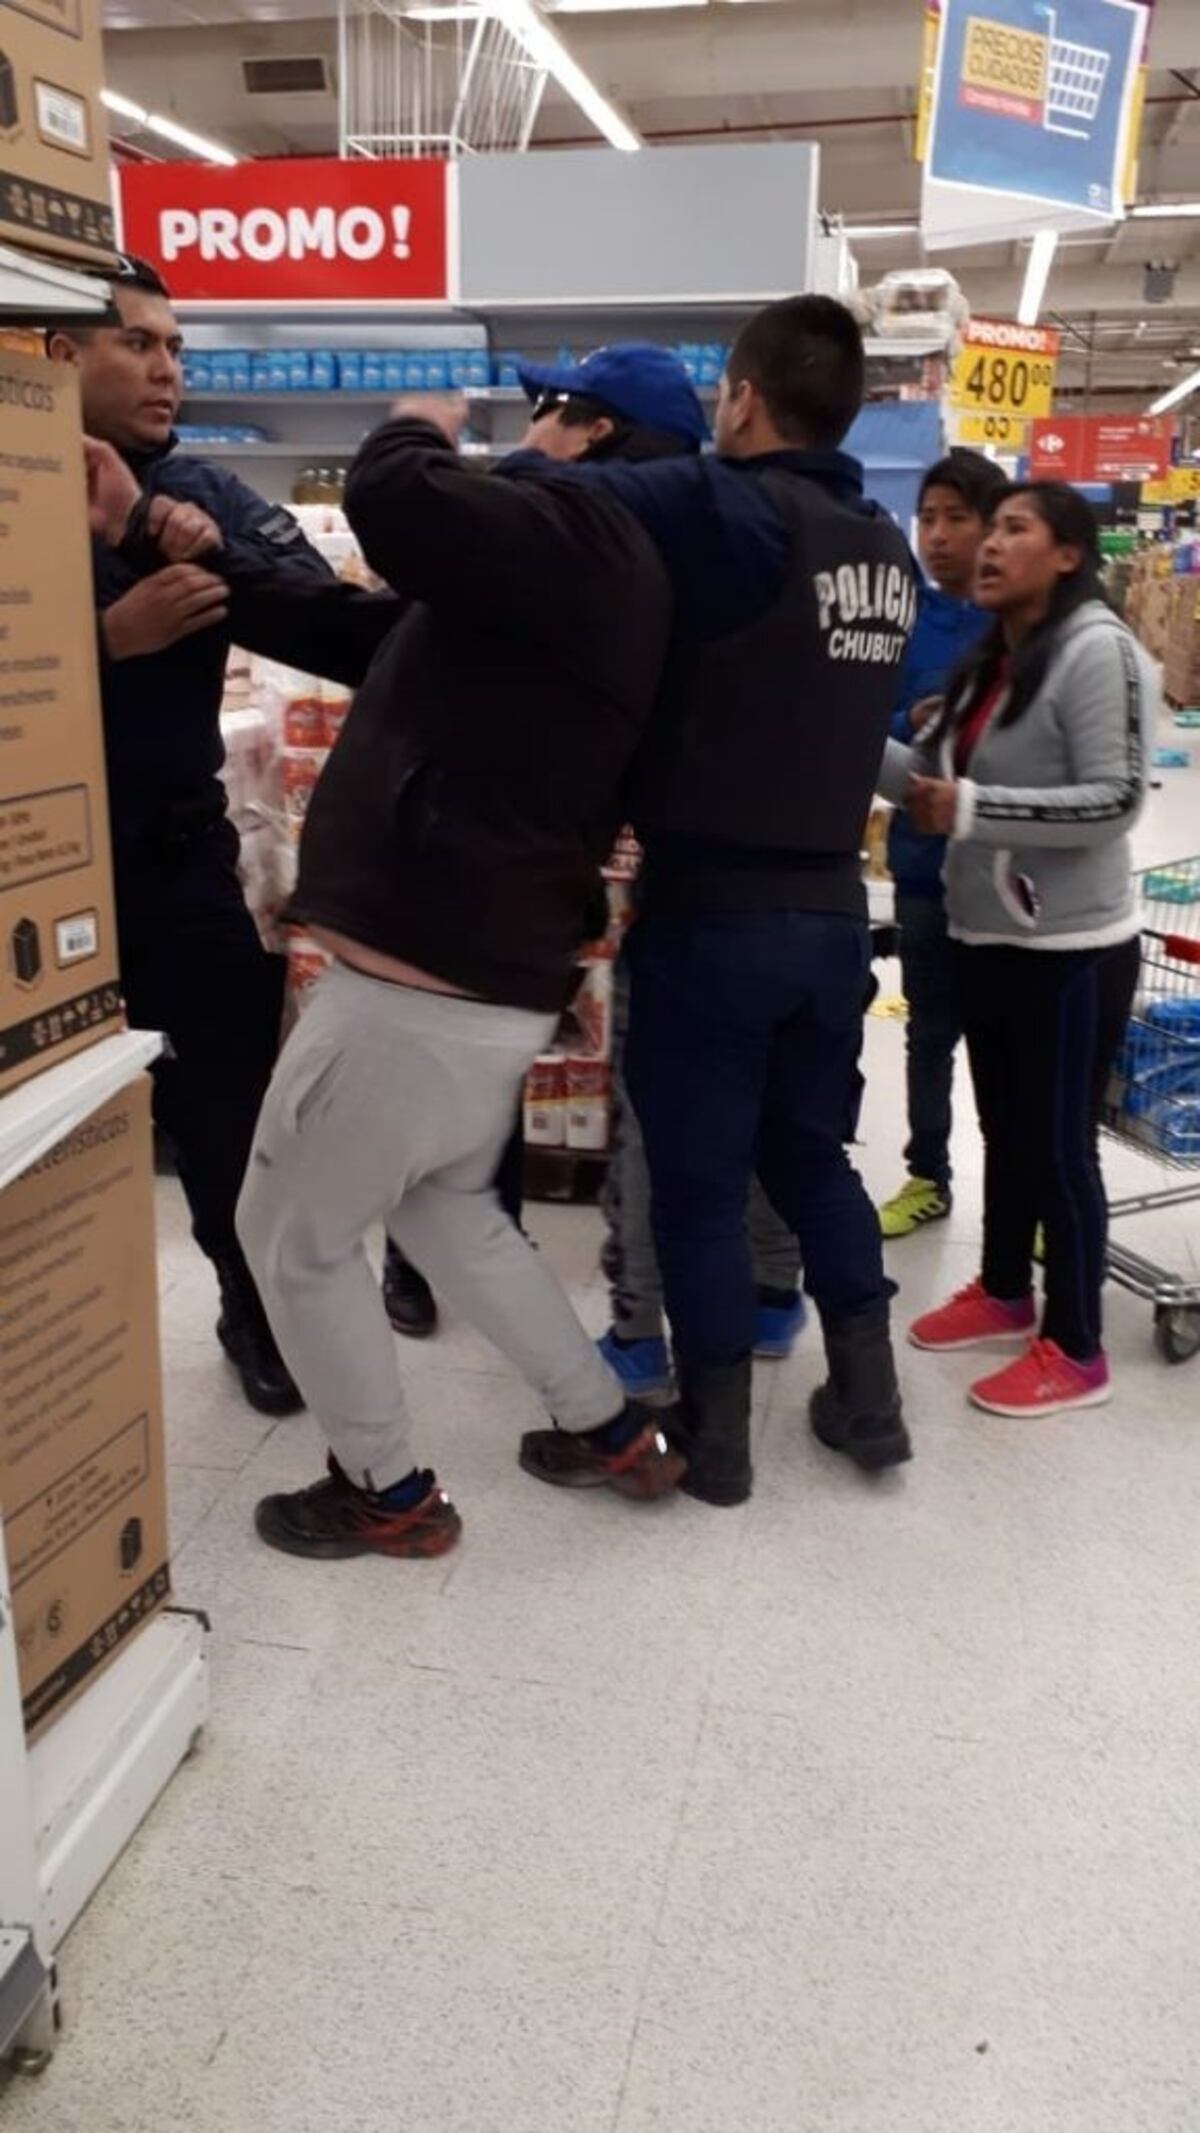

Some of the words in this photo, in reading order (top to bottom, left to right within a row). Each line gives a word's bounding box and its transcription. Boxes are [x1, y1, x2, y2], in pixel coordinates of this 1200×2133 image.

[972, 24, 1044, 67] PRECIOS
[968, 53, 1041, 91] CUIDADOS
[159, 205, 411, 261] PROMO!
[968, 320, 1046, 352] PROMO!
[828, 628, 906, 663] CHUBUT
